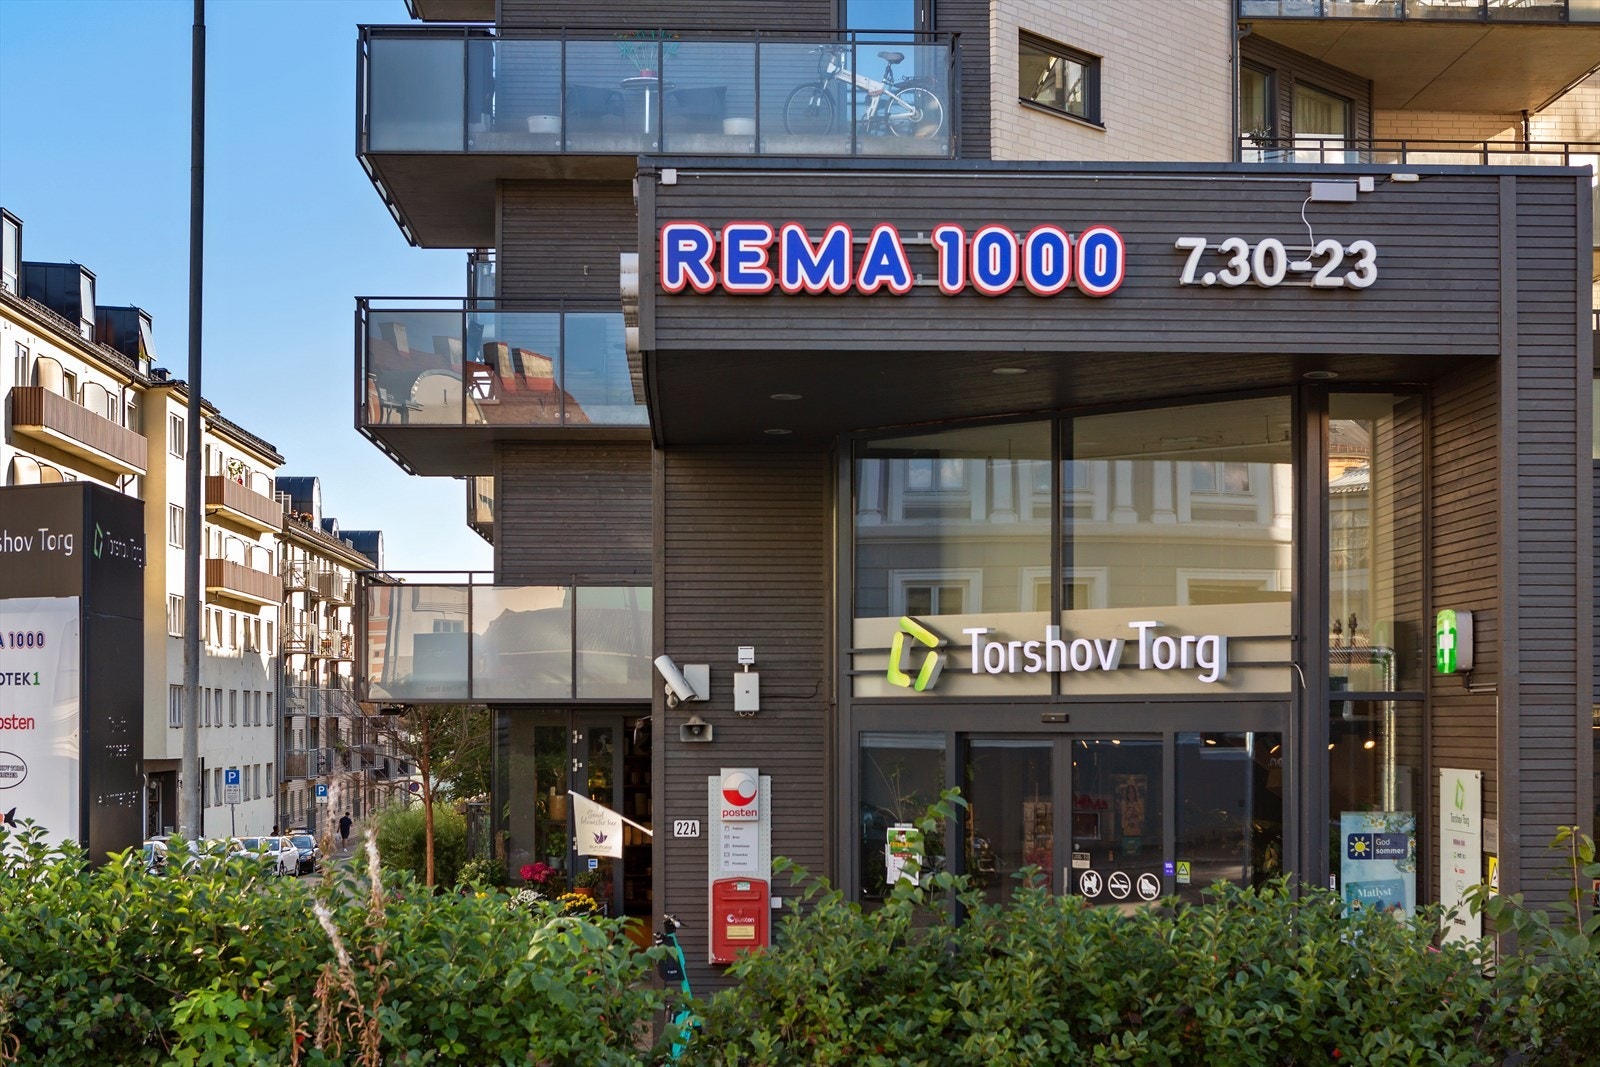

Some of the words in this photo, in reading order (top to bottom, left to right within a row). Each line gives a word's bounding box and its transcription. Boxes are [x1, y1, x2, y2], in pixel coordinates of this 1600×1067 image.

[660, 221, 913, 295] REMA
[931, 223, 1127, 298] 1000
[1175, 237, 1378, 290] 7.30-23
[0, 529, 34, 553] hov
[38, 528, 74, 556] Torg
[8, 631, 46, 649] 1000
[962, 624, 1124, 675] Torshov
[1128, 620, 1227, 683] Torg
[229, 772, 237, 783] P
[318, 786, 325, 796] P
[722, 808, 757, 818] posten
[676, 821, 697, 835] 22A
[1375, 838, 1391, 846] God
[1358, 887, 1392, 899] Matlyst
